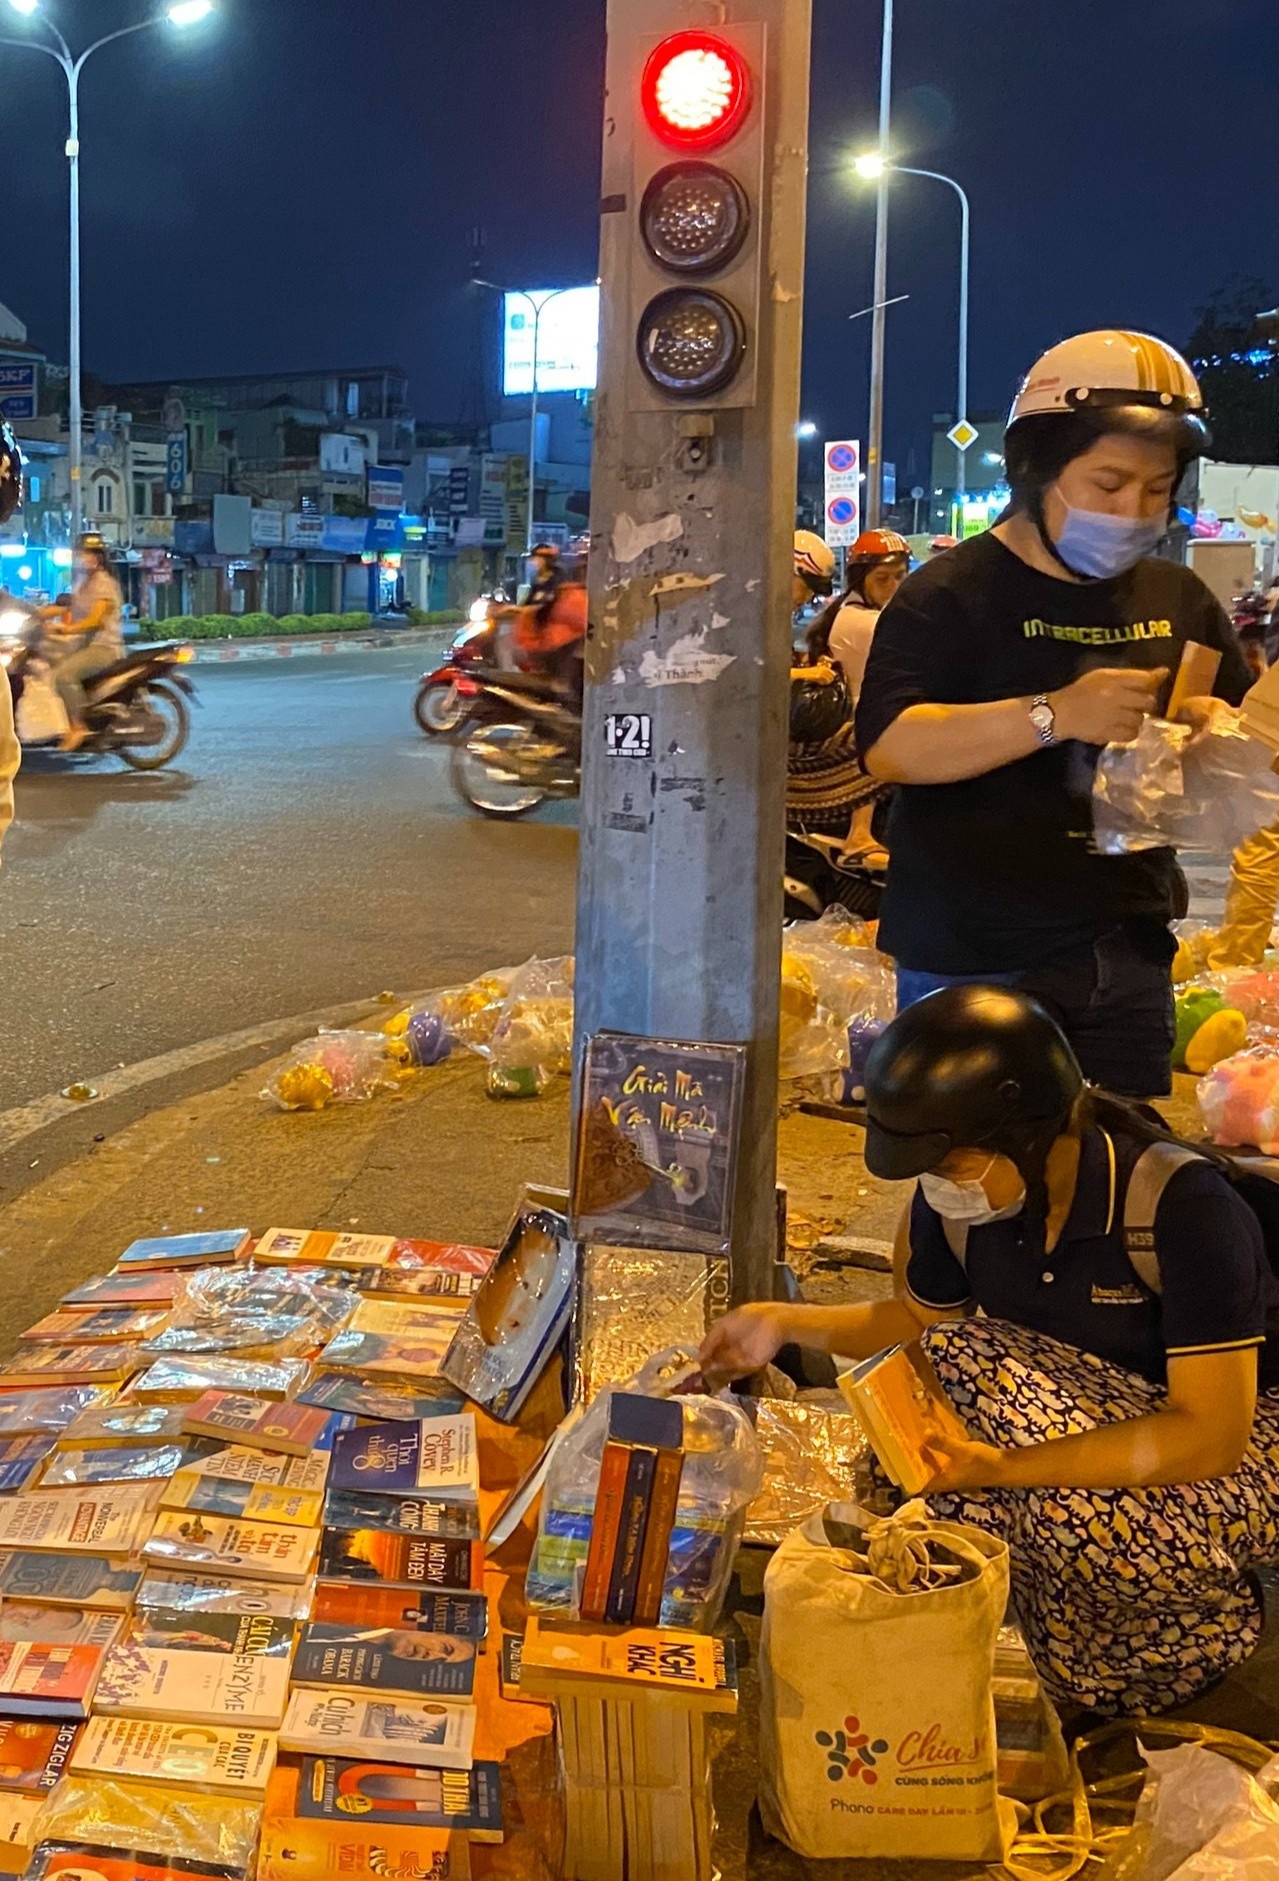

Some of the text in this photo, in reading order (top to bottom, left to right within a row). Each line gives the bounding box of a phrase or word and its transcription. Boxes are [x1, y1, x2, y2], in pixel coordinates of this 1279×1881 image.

[1023, 618, 1173, 645] INTRACELLULAR
[422, 1433, 443, 1472] Covey
[320, 1648, 338, 1675] OBAMA
[336, 1648, 354, 1679] BARACK
[224, 1655, 255, 1711] ENZYME
[40, 1724, 77, 1787] ZIG ZIGLAR
[161, 1728, 219, 1776] CEO
[896, 1723, 964, 1766] Chia
